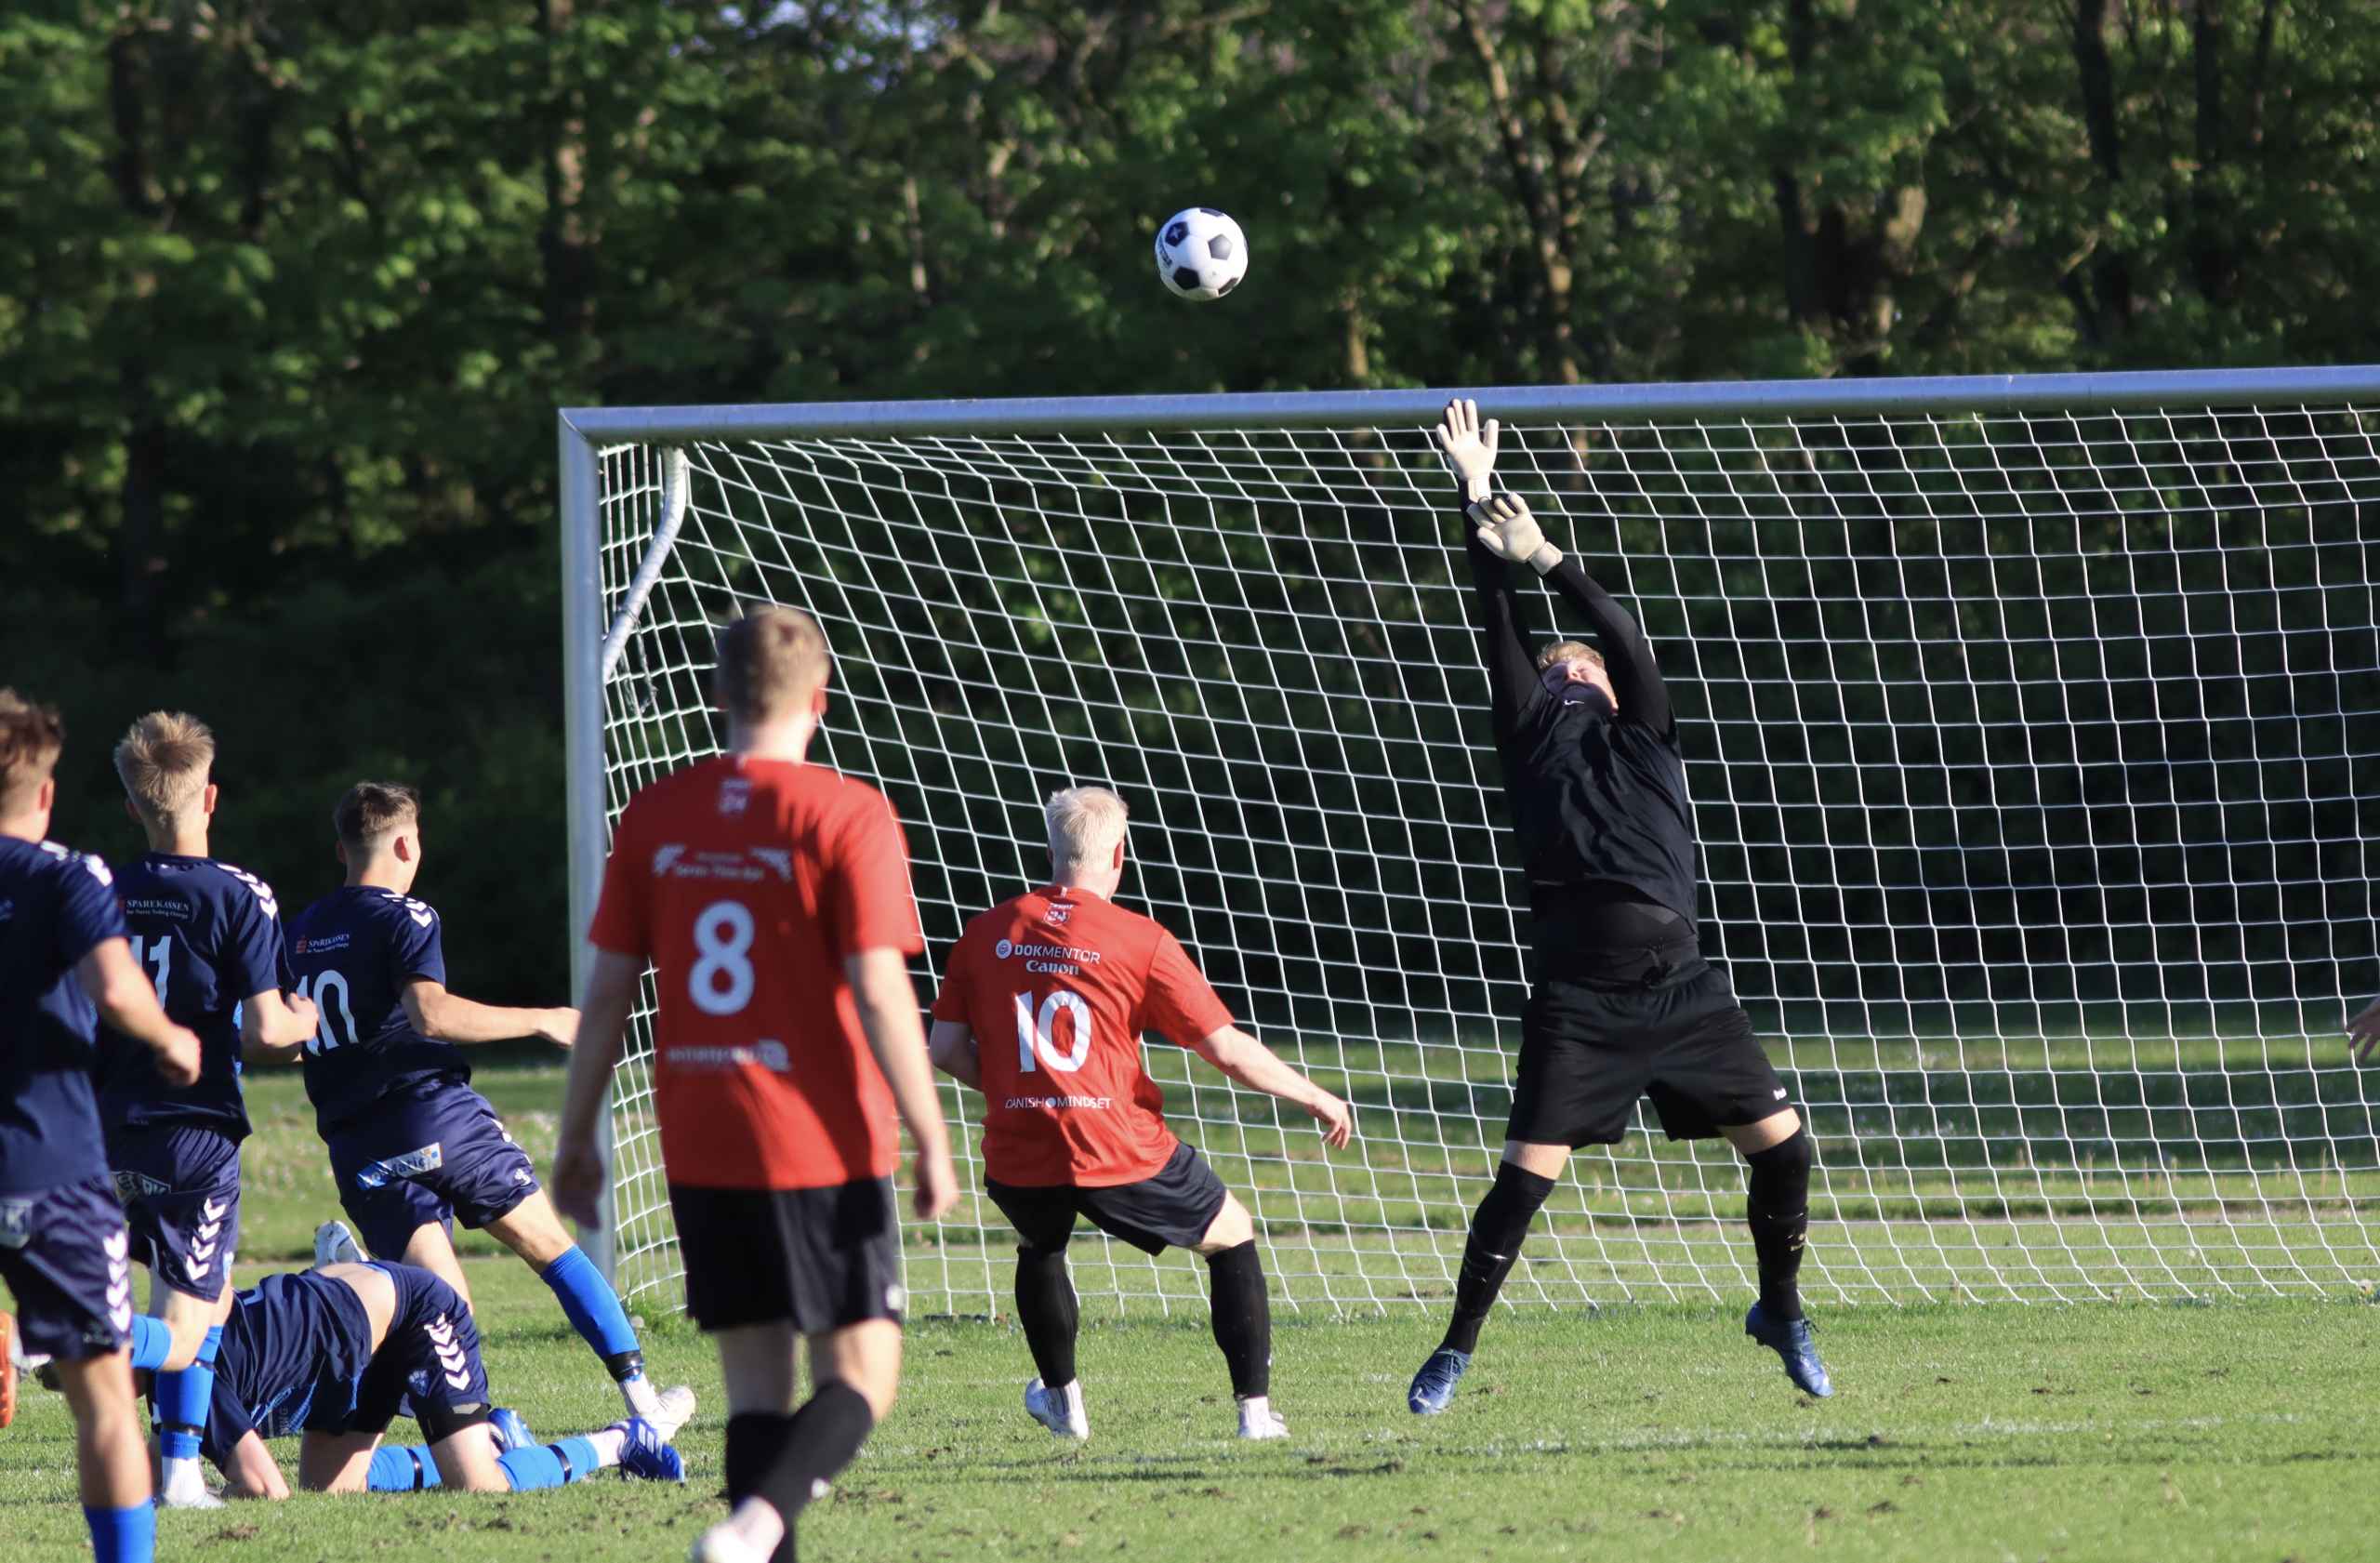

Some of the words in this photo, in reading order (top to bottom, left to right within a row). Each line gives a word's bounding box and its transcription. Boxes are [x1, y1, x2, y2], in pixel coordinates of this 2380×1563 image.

[688, 899, 755, 1015] 8
[1014, 944, 1101, 964] DOKMENTOR
[1025, 960, 1079, 975] Canon
[1014, 990, 1091, 1072] 10
[1057, 1095, 1113, 1109] MINDSET
